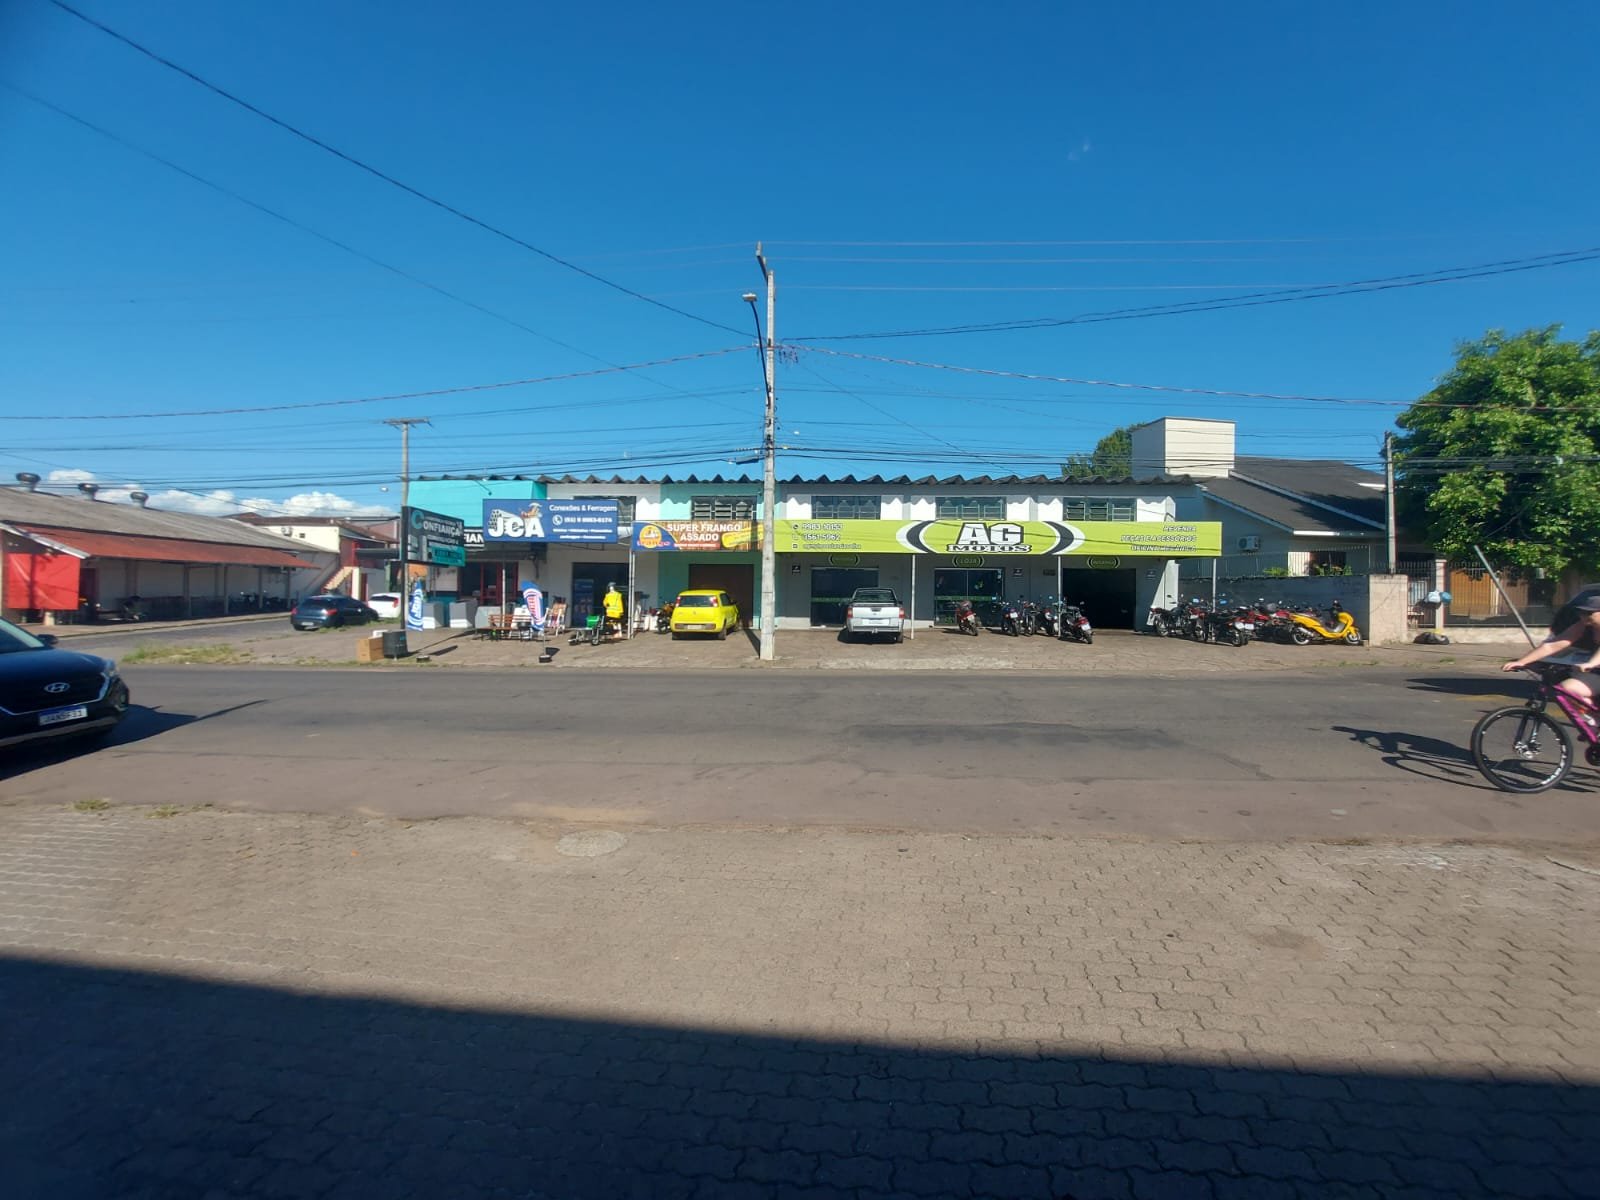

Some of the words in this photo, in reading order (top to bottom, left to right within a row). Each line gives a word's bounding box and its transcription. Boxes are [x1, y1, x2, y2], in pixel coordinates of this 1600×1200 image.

[488, 517, 545, 538] JCA
[667, 523, 700, 532] SUPER
[701, 523, 741, 532] FRANGO
[680, 533, 719, 542] ASSADO
[956, 522, 1025, 545] AG
[946, 544, 1033, 553] MOTOS
